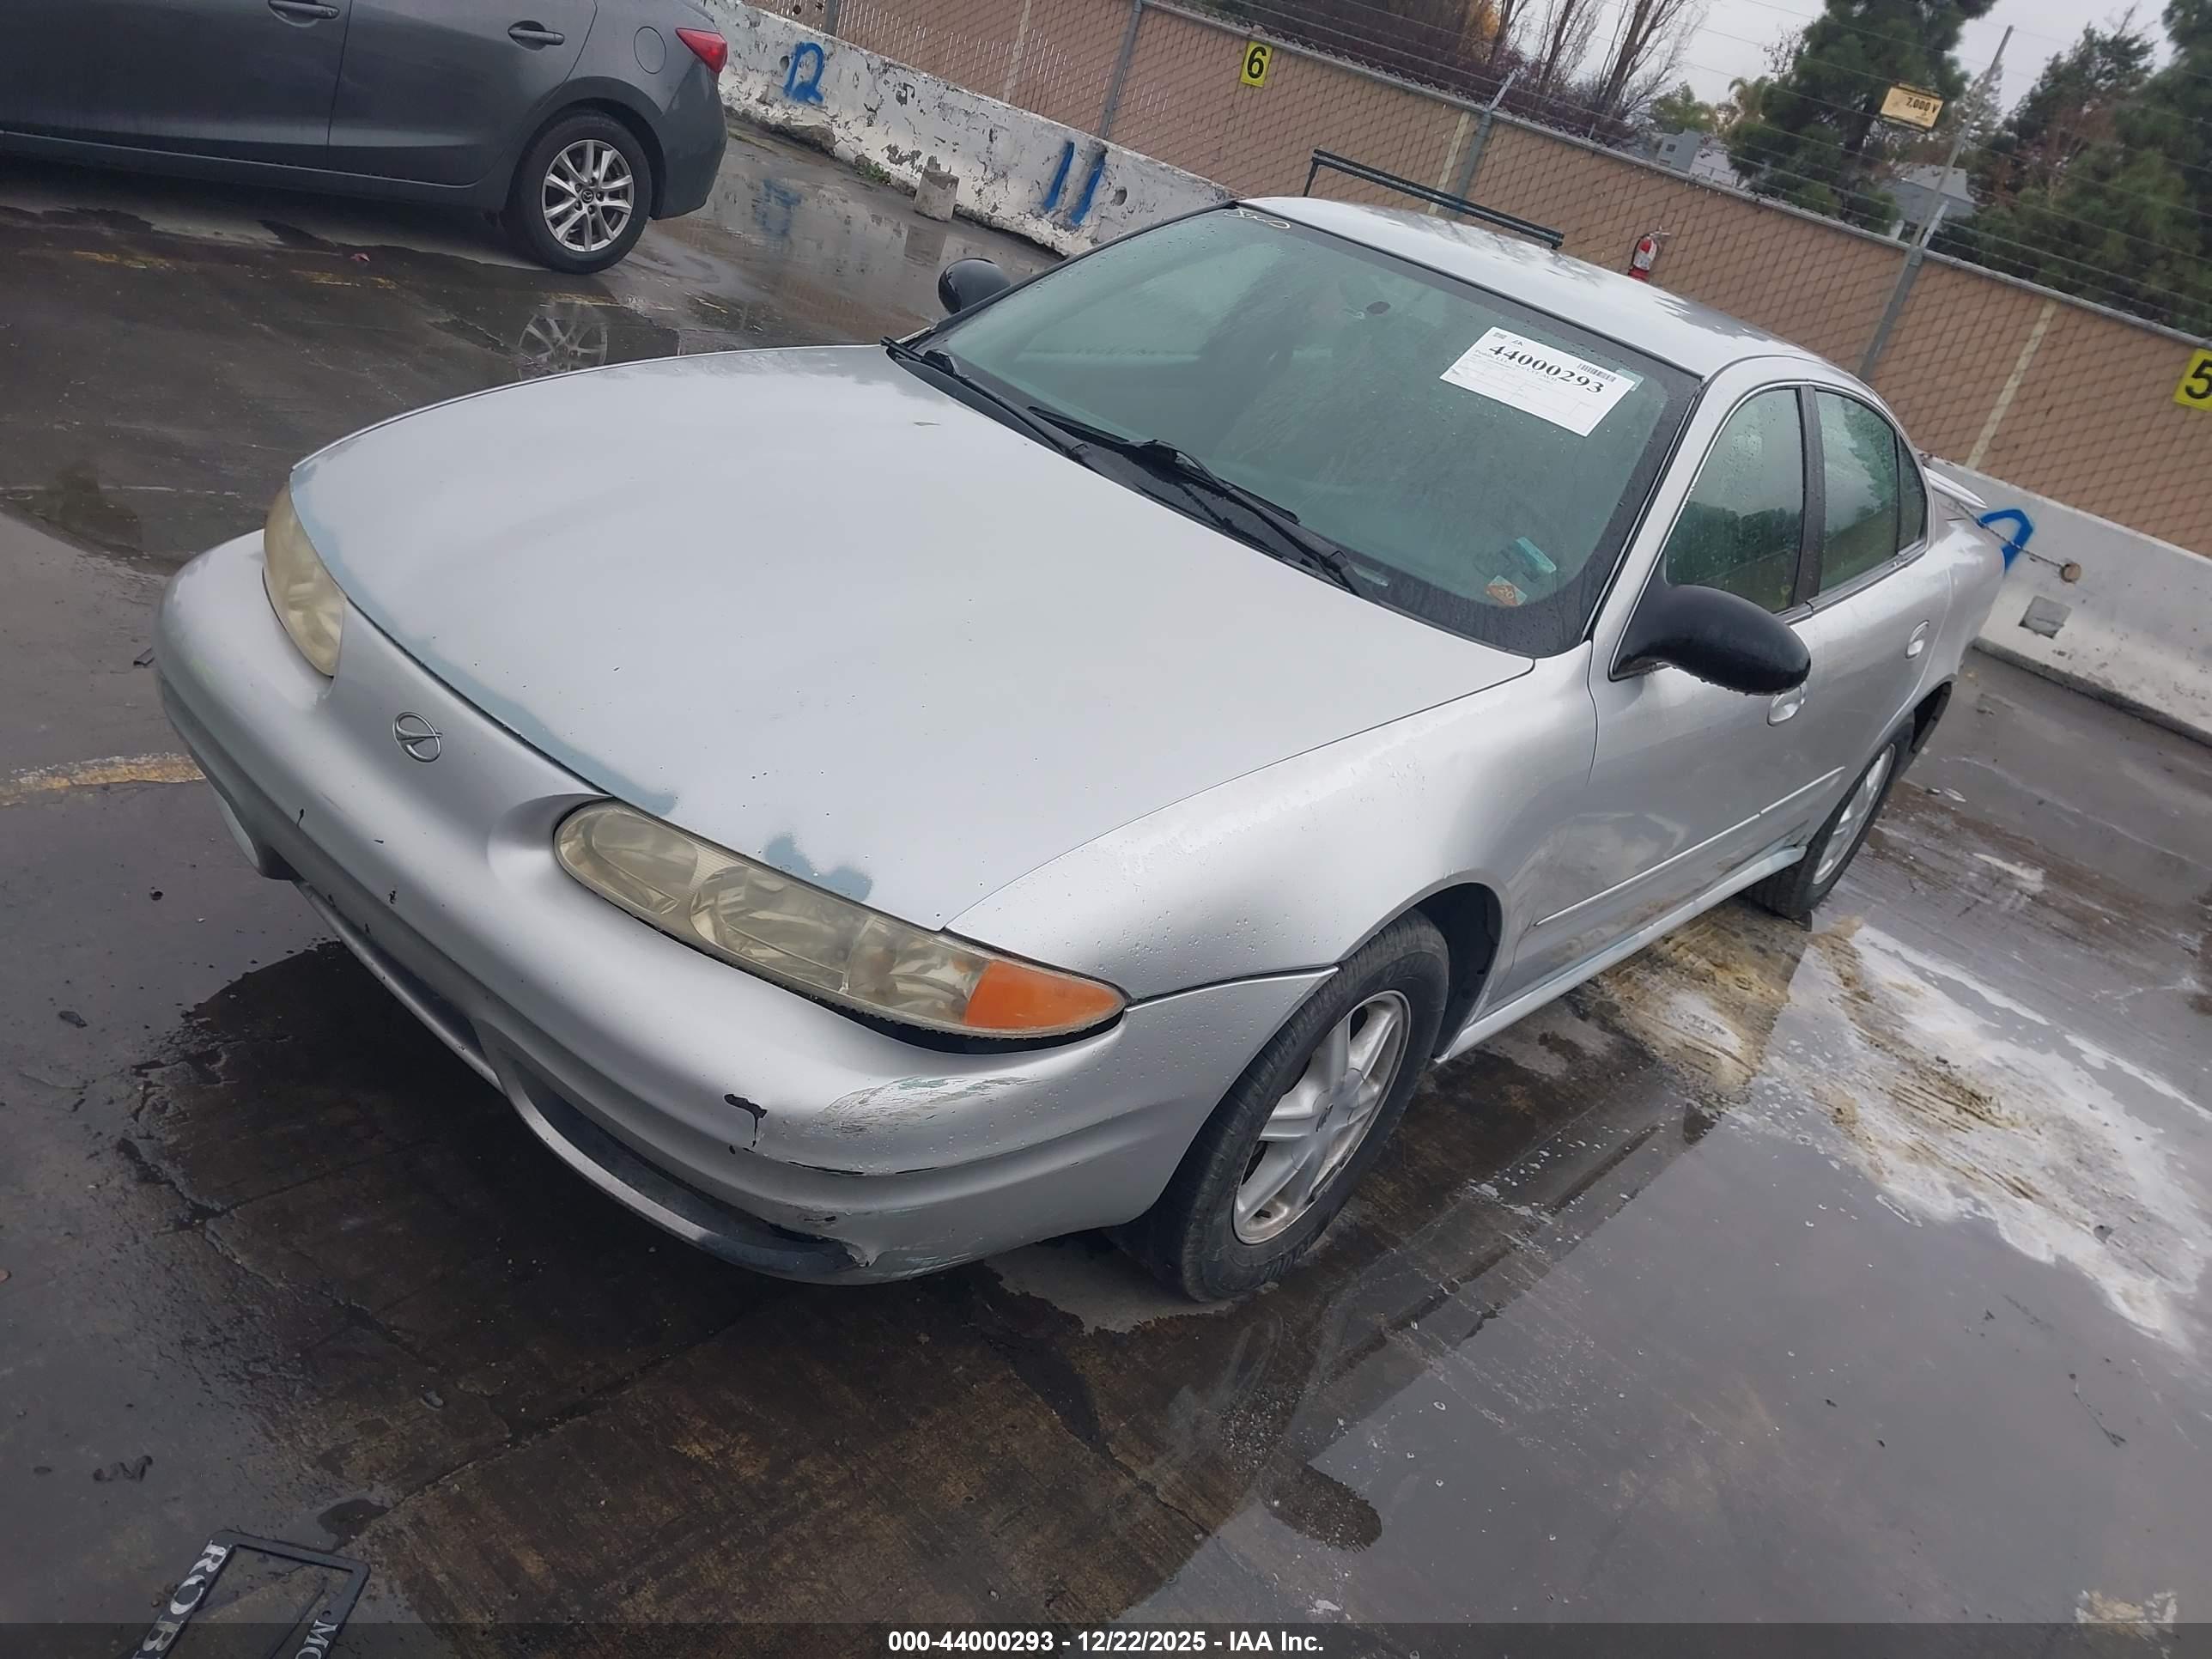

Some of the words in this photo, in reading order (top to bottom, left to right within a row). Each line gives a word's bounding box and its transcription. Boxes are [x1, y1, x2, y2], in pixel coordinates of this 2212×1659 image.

[1248, 46, 1267, 78] 6
[1905, 96, 1932, 112] 7,000
[1488, 345, 1605, 394] 44000293
[2185, 358, 2212, 399] 5
